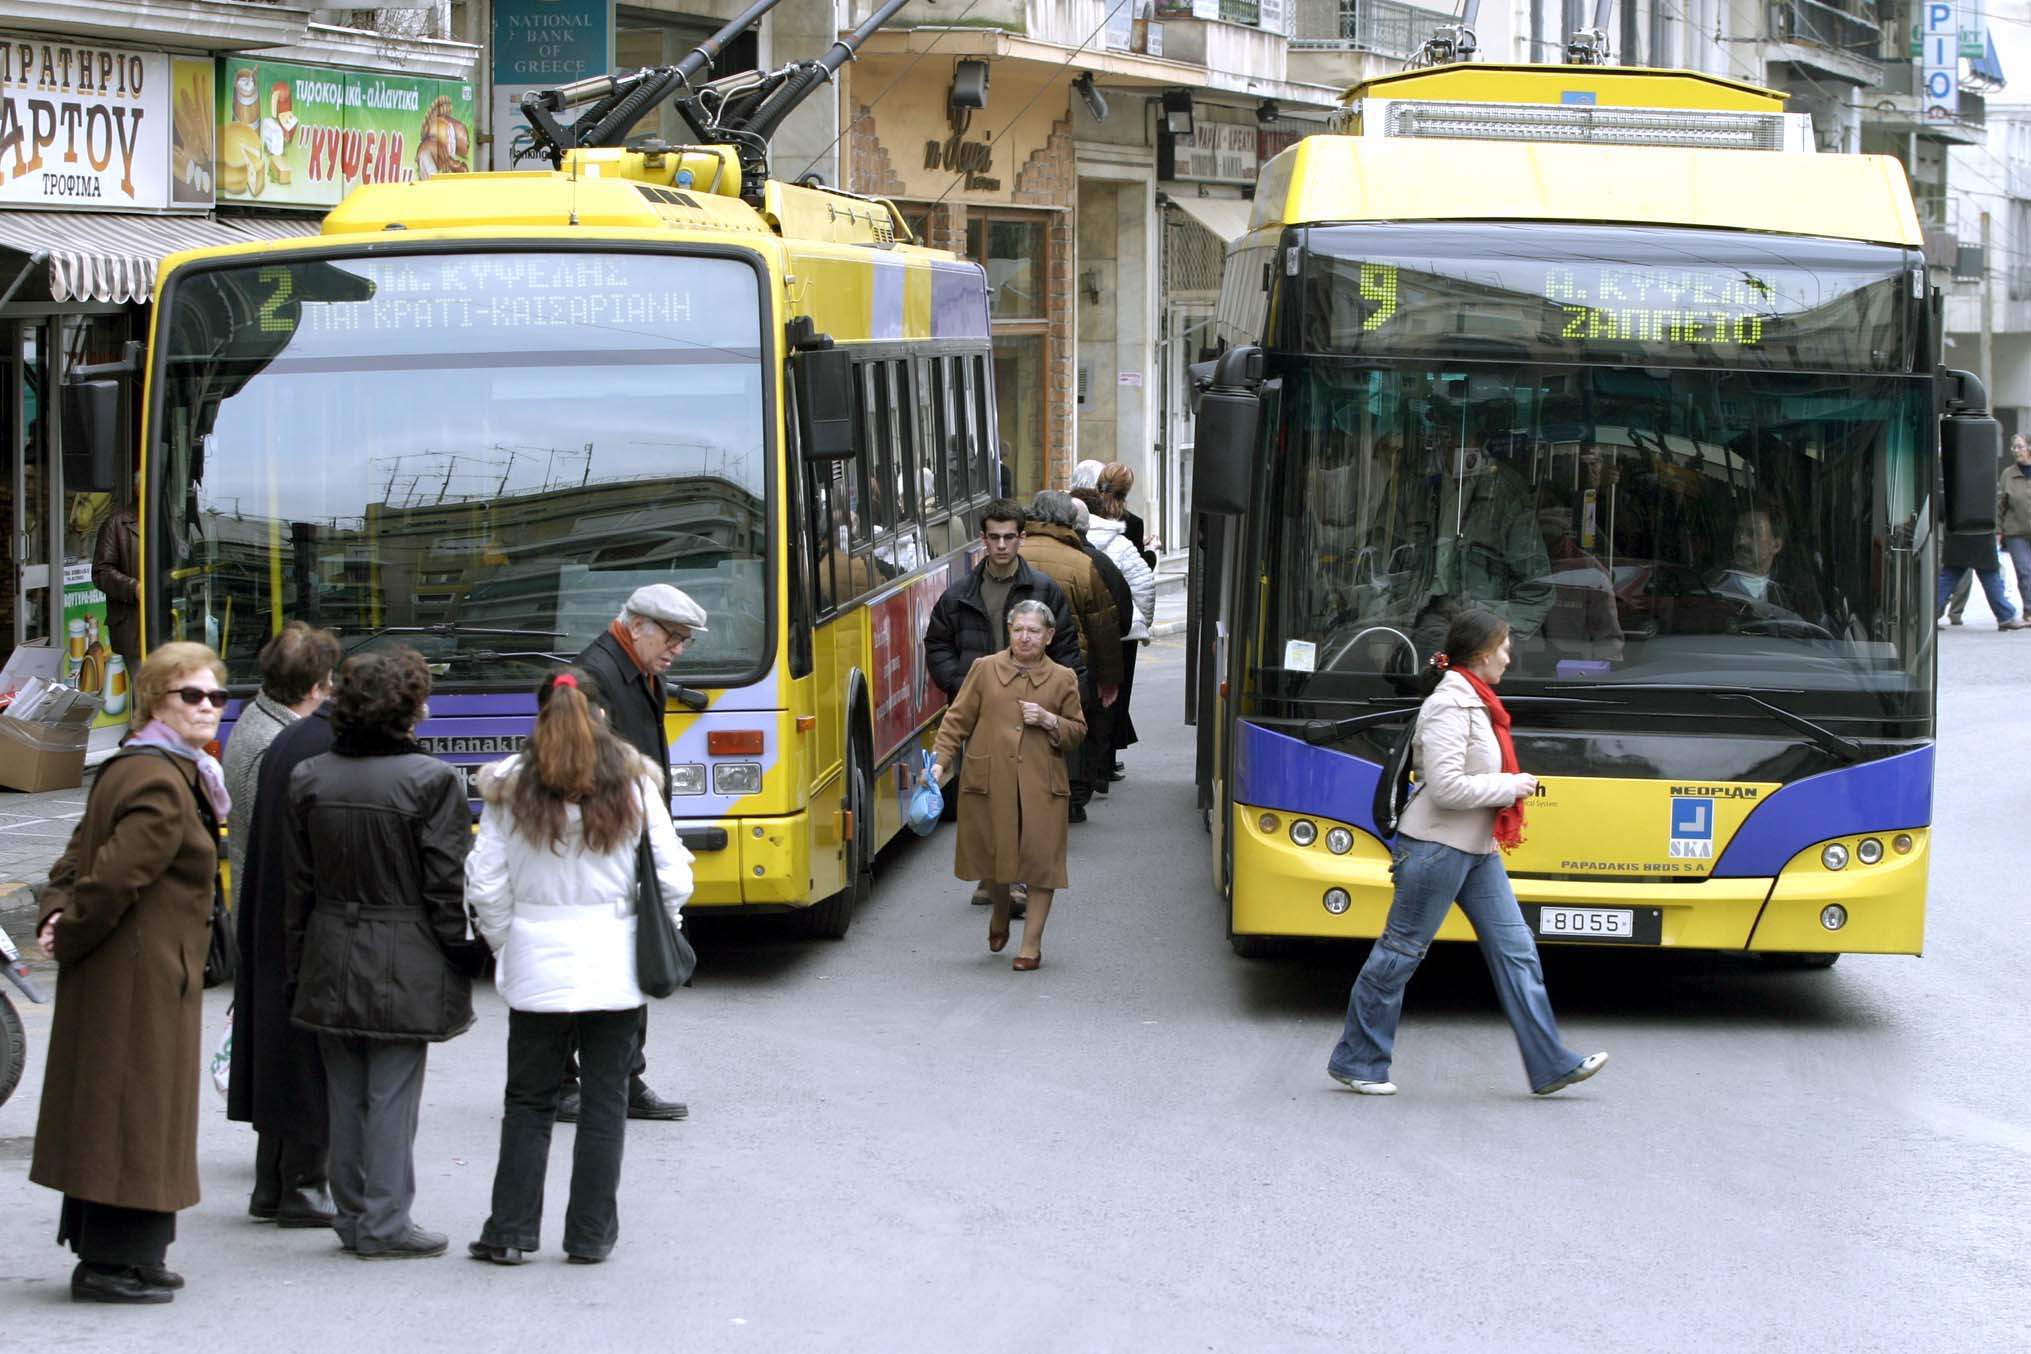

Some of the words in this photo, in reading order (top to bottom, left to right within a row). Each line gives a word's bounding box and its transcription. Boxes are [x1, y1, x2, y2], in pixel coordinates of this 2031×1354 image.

[509, 14, 593, 27] NATIONAL
[527, 29, 575, 43] BANK
[539, 45, 561, 57] OF
[514, 60, 586, 73] GREECE
[0, 97, 144, 200] ΑΡΤΟΥ
[43, 173, 101, 198] ΤΡΟΦΙΜΑ
[259, 267, 294, 332] 2
[1360, 262, 1398, 331] 9
[1670, 786, 1758, 799] NEOPLAN
[1670, 841, 1712, 858] SKA
[1561, 860, 1640, 873] PAPADAKIS
[1643, 863, 1679, 873] BROS
[1554, 912, 1619, 932] 8055
